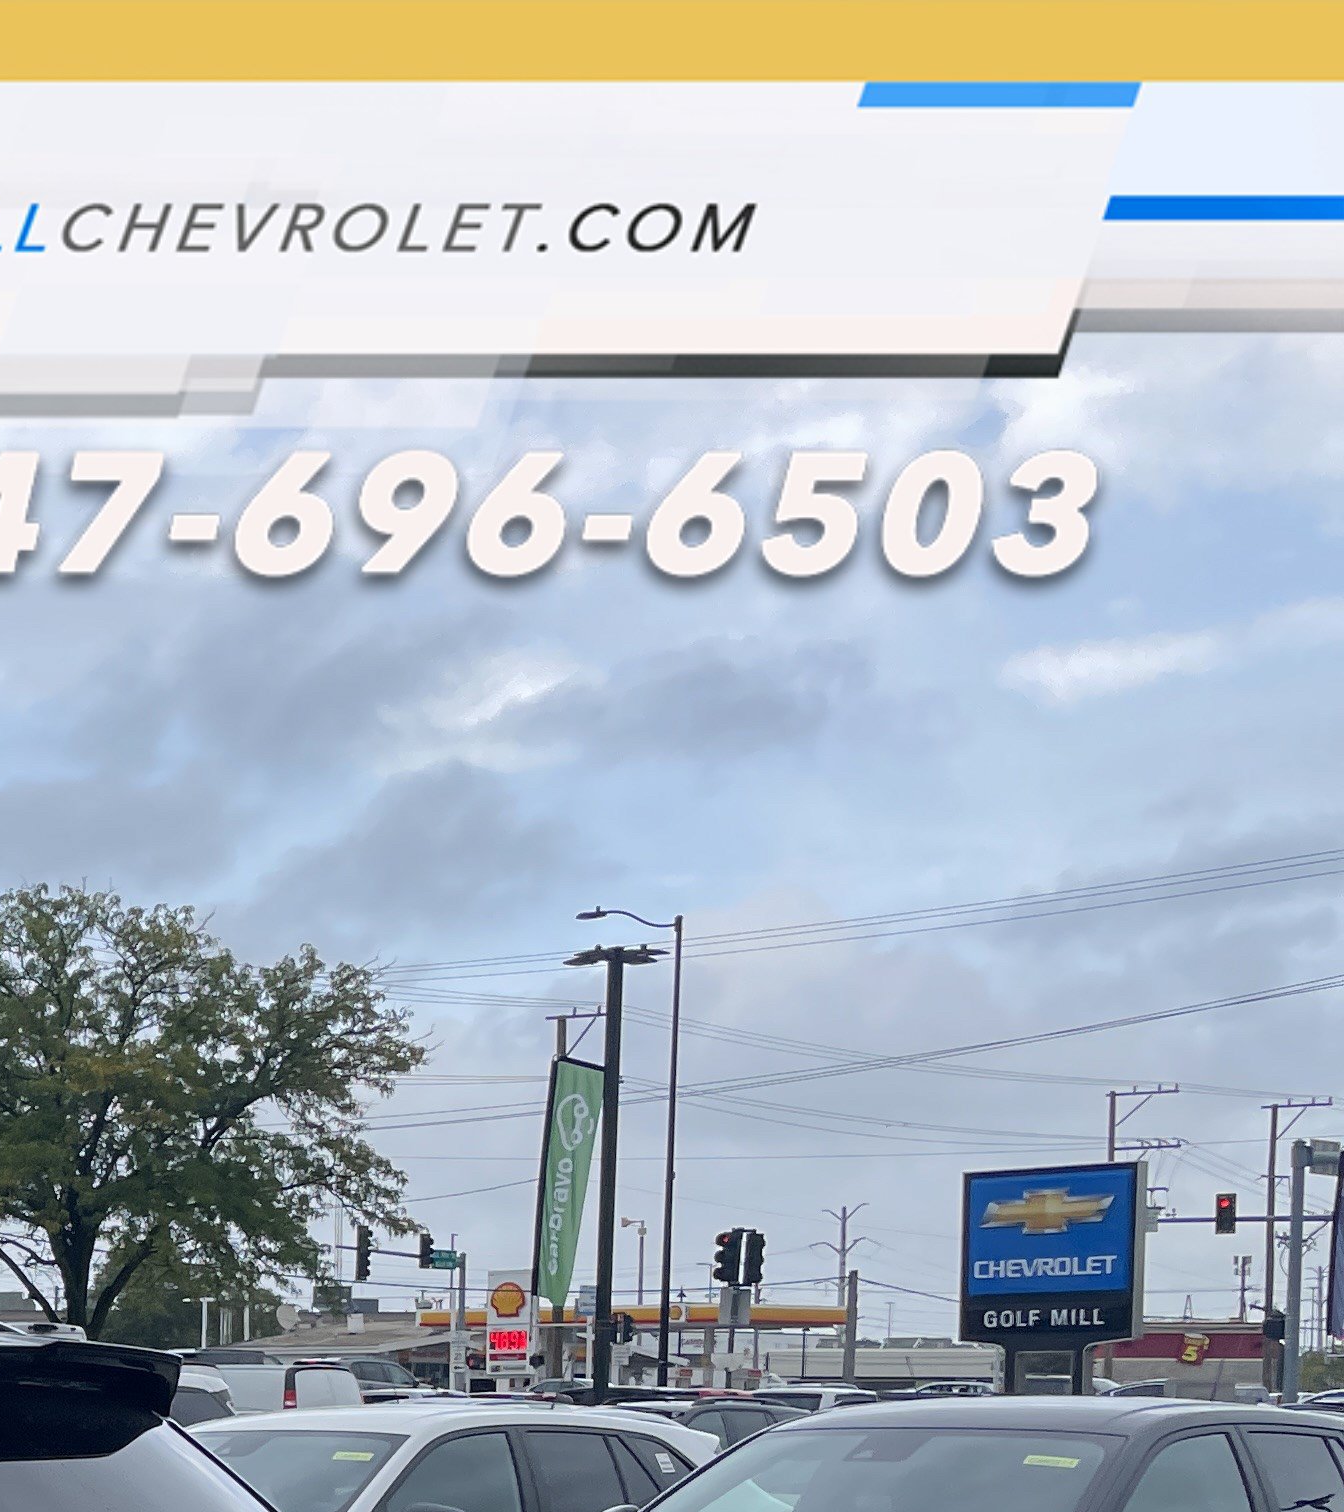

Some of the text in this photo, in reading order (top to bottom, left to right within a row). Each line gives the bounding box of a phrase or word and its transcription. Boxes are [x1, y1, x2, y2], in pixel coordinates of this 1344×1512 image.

[973, 1255, 1118, 1279] CHEVROLET
[983, 1308, 1106, 1329] GOLF MILL
